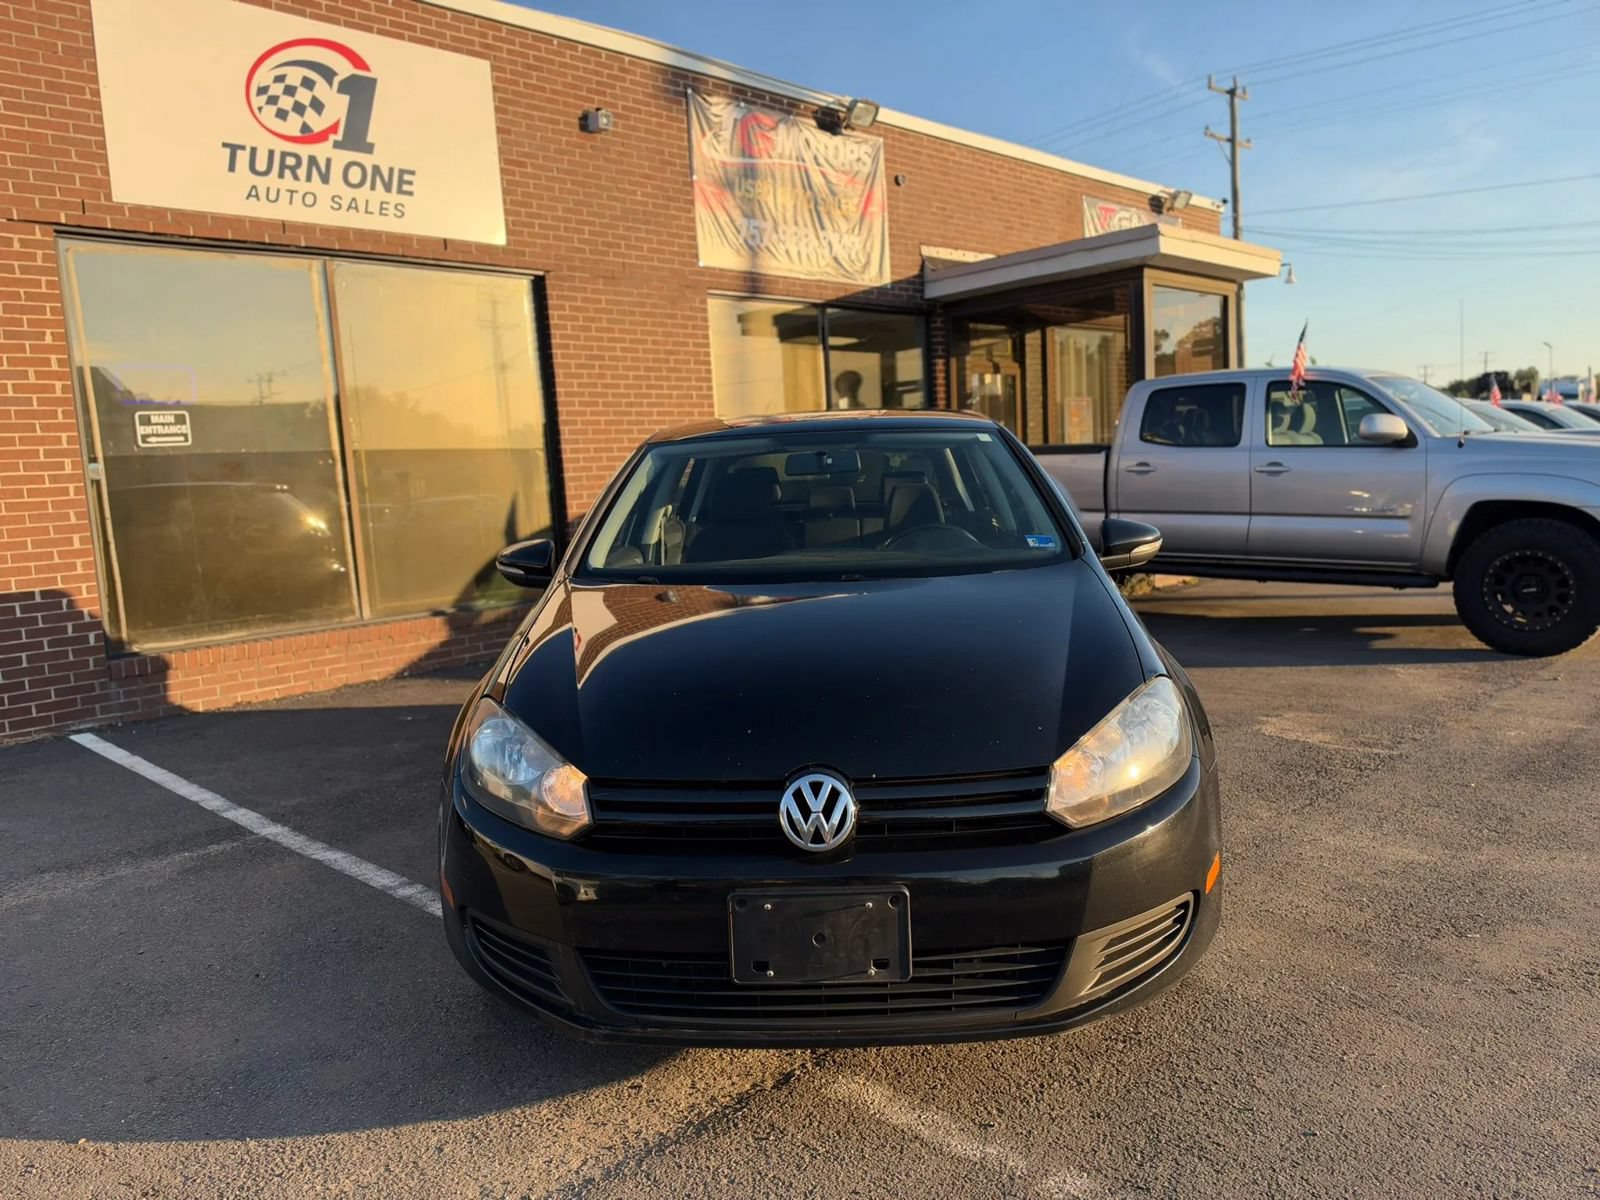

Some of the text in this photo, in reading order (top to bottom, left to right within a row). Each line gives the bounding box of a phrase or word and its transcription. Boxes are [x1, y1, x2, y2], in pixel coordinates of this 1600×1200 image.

[221, 141, 416, 197] TURN ONE
[245, 184, 406, 219] AUTO SALES
[139, 424, 189, 435] ENTRANCE
[150, 414, 176, 424] MAIN
[781, 775, 853, 850] VW
